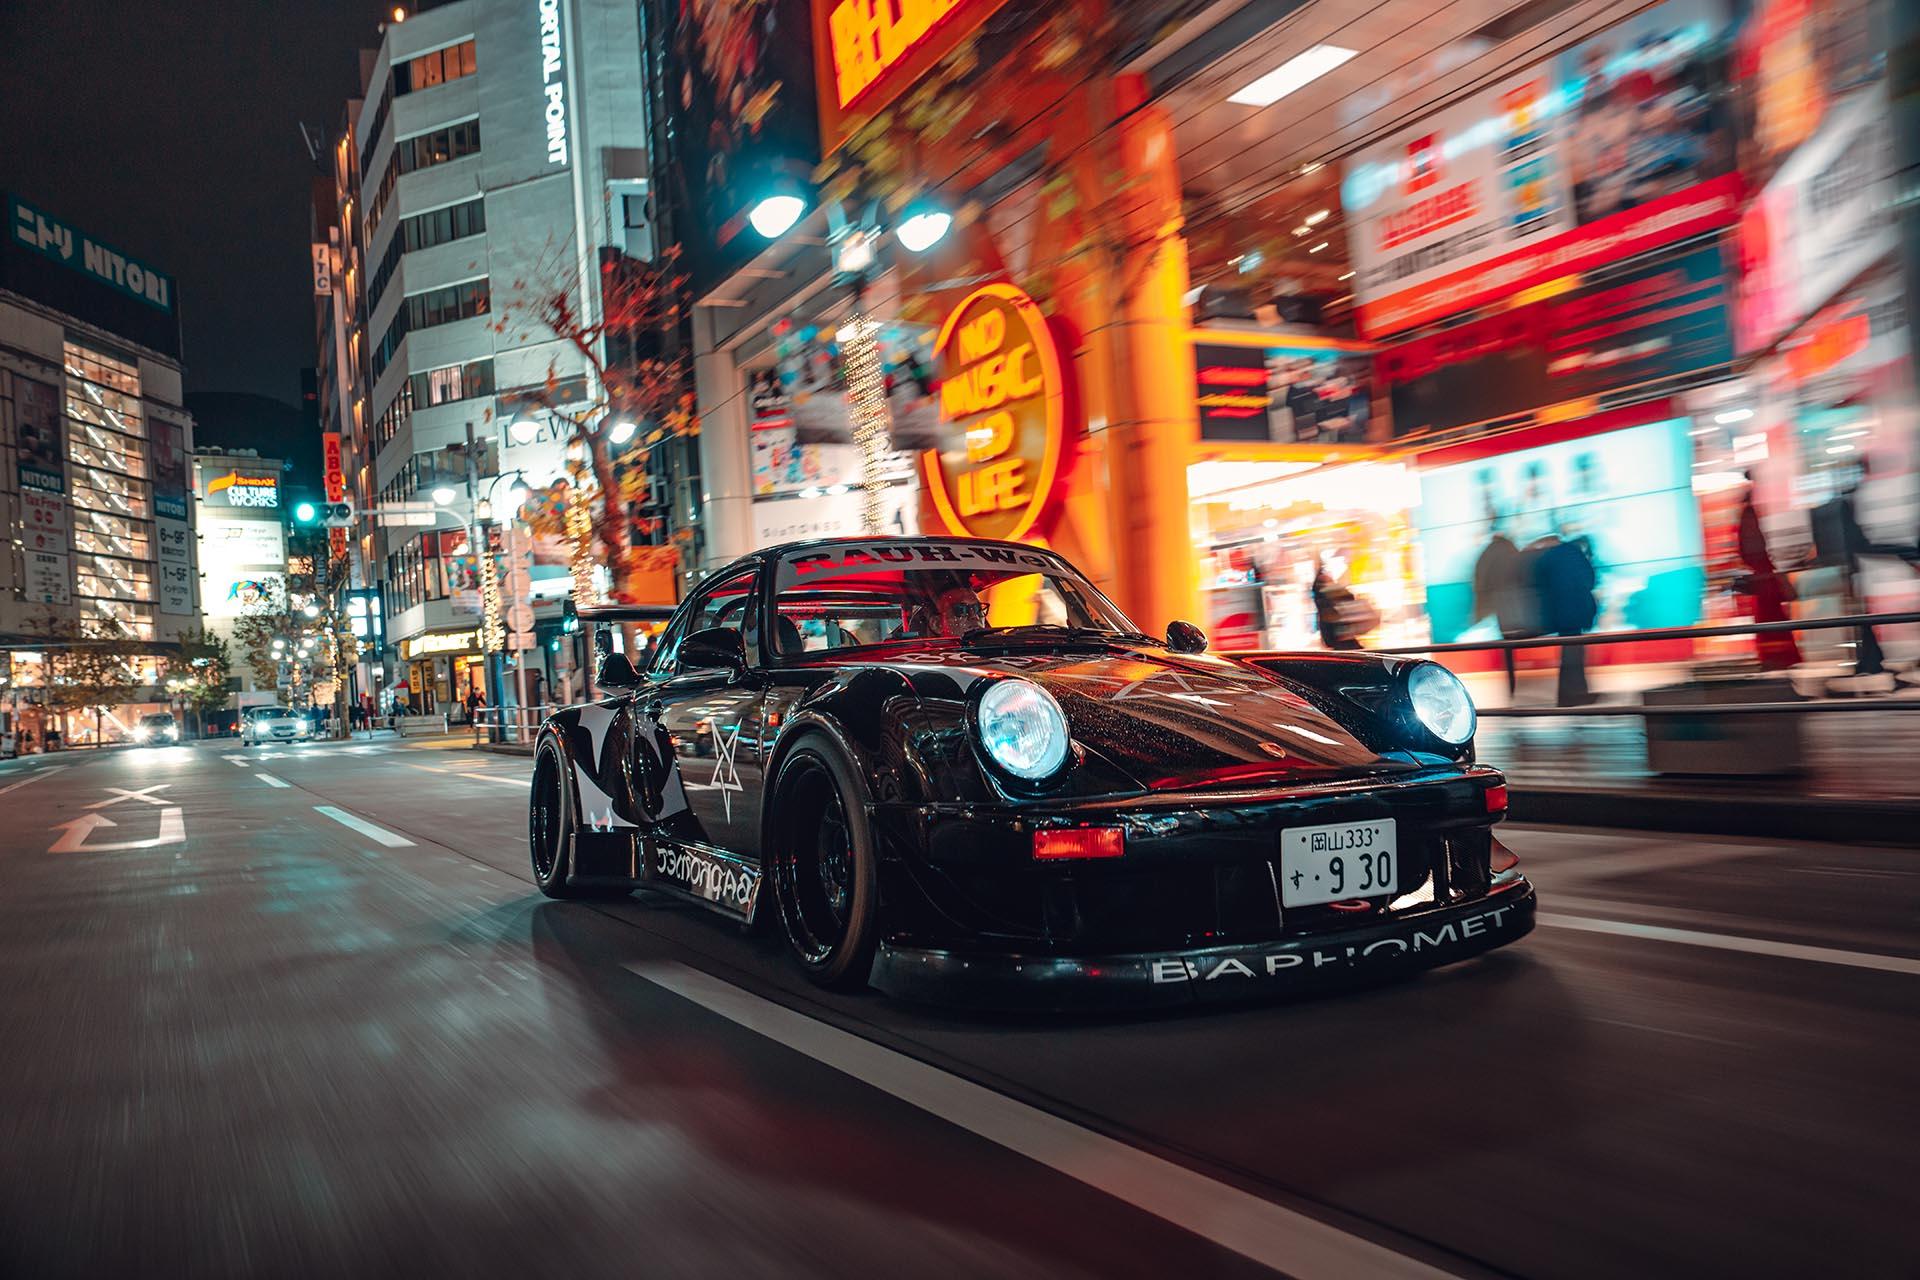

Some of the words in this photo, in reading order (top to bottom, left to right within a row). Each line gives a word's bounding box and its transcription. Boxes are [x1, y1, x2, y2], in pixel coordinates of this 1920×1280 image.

[544, 81, 568, 166] POINT
[15, 204, 74, 260] ニトリ
[83, 238, 170, 308] NITORI
[958, 306, 1007, 366] NO
[965, 409, 1016, 464] NO
[22, 471, 61, 488] NITORI
[235, 475, 277, 487] SHIDAX
[956, 457, 1034, 518] LIFE
[227, 485, 277, 499] CULTURE
[228, 495, 278, 508] WORKS
[157, 502, 185, 517] NITORI
[1290, 870, 1304, 890] す
